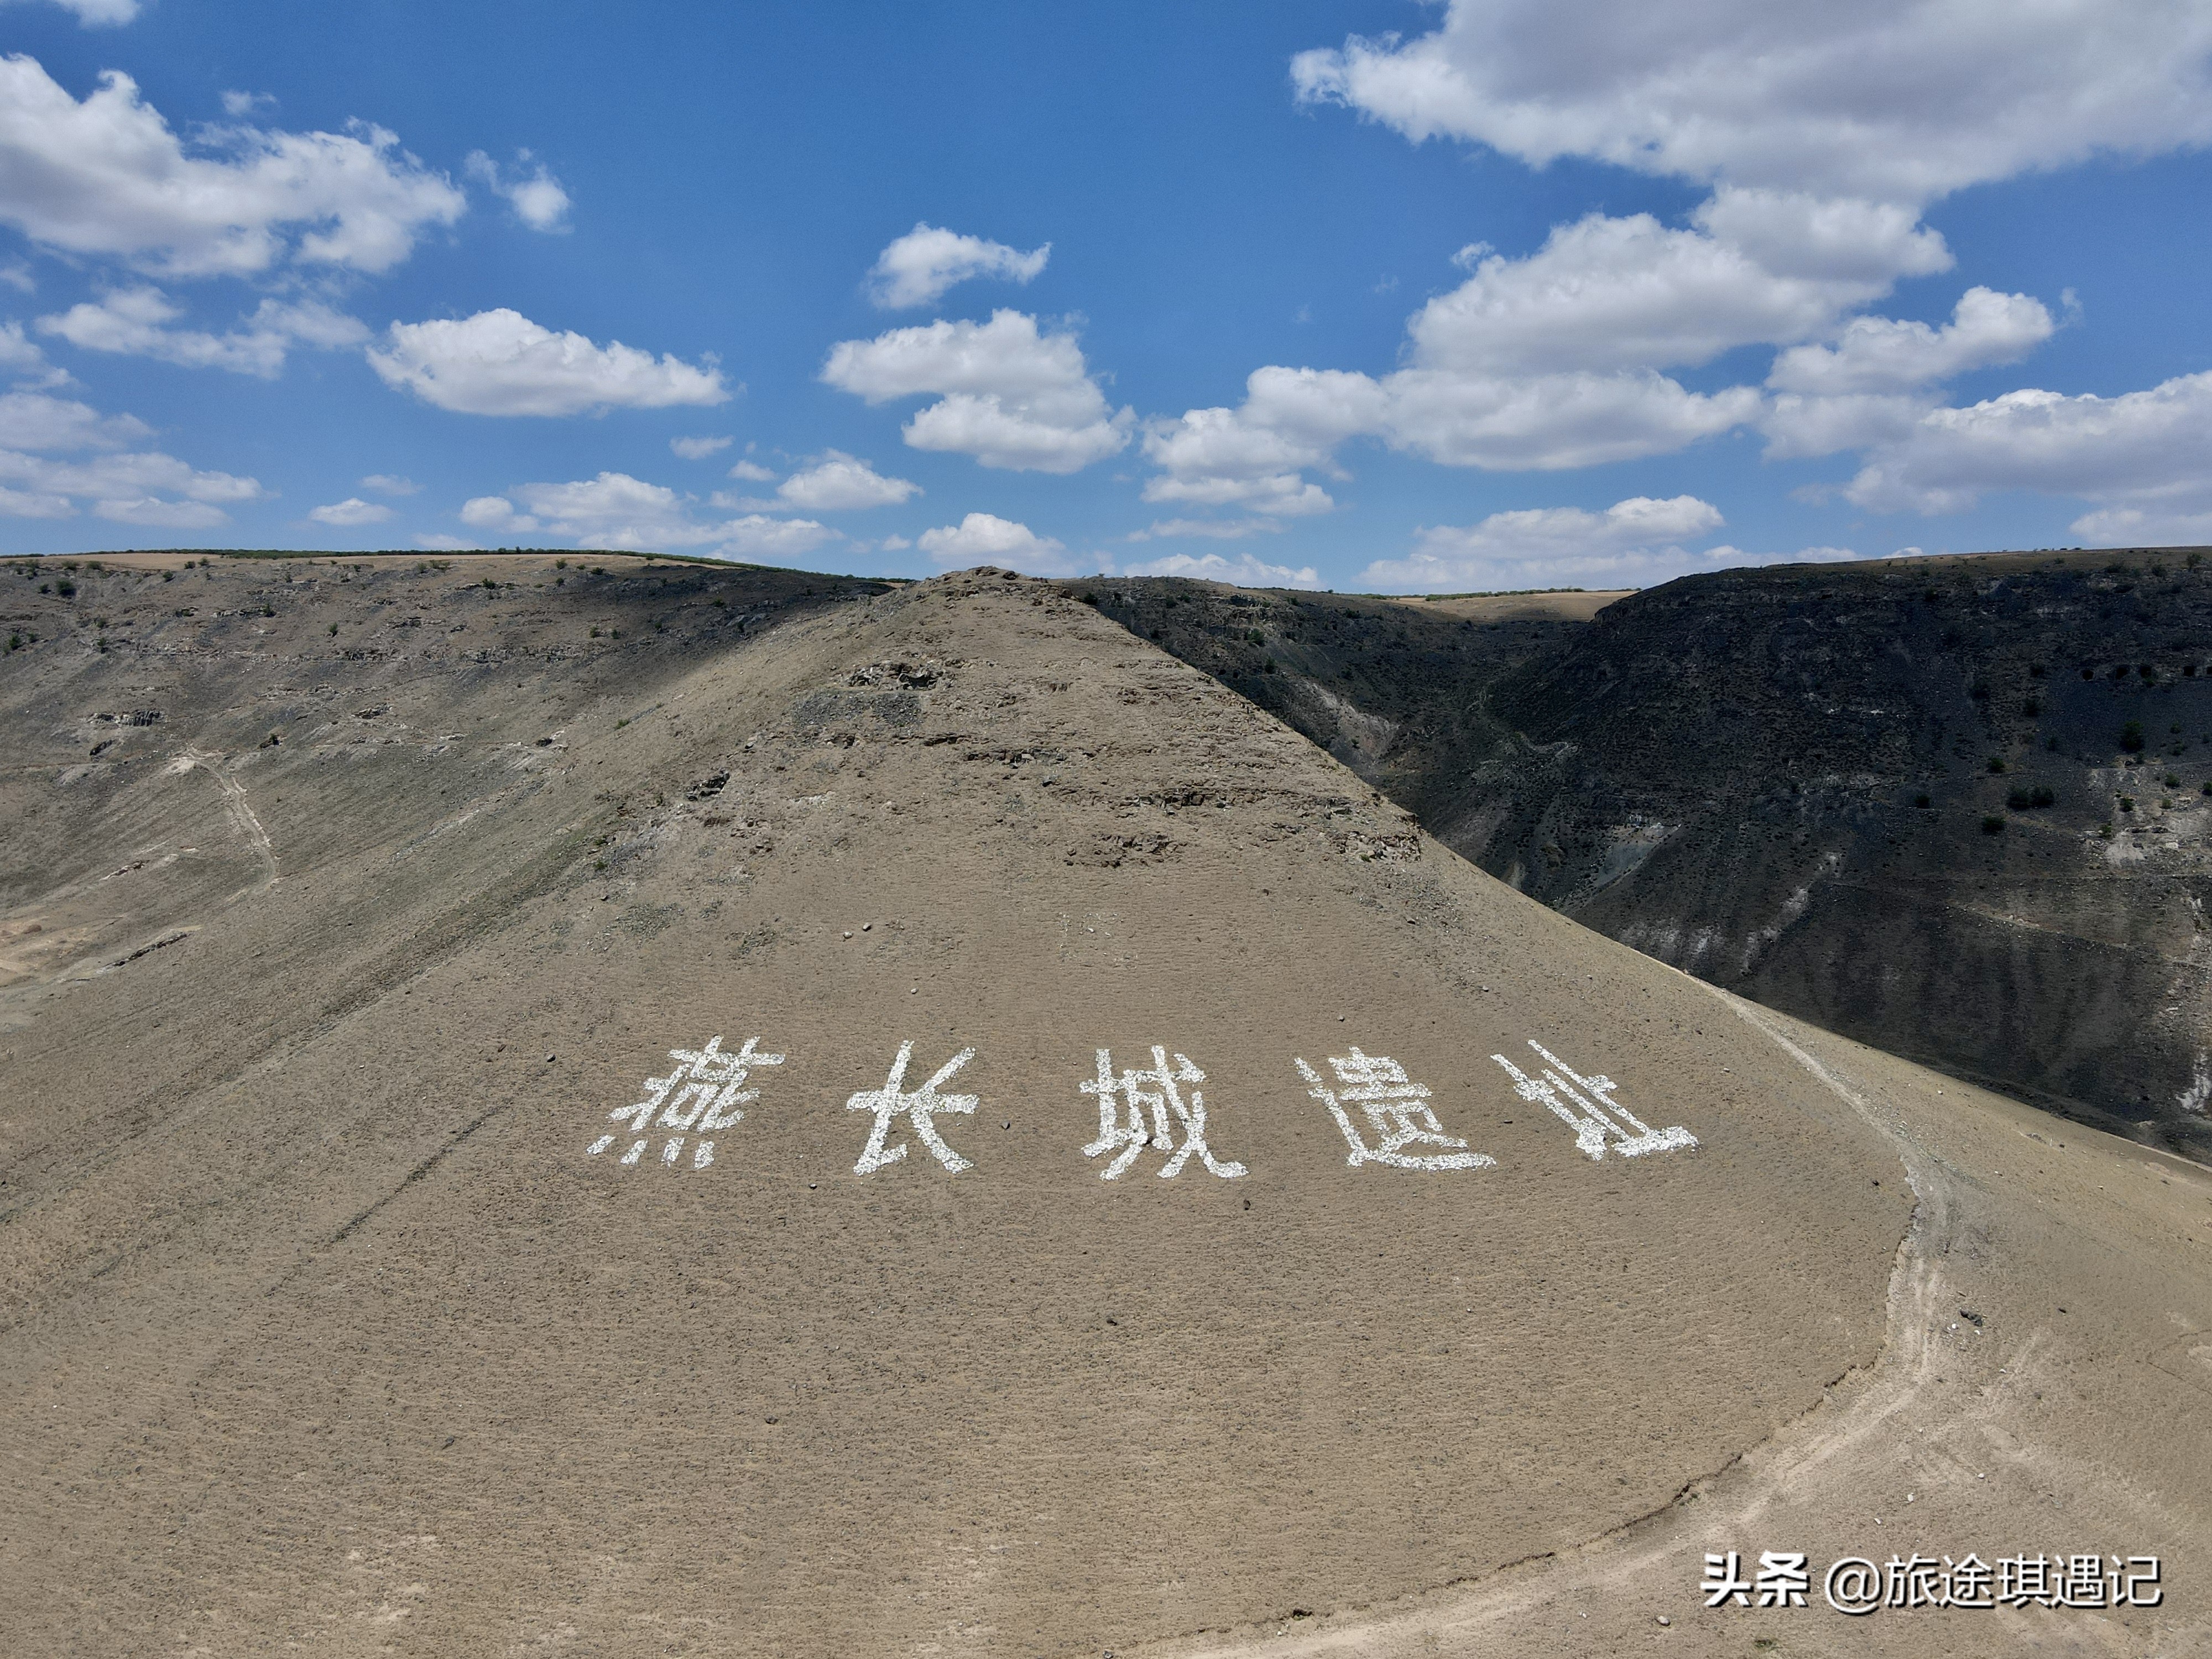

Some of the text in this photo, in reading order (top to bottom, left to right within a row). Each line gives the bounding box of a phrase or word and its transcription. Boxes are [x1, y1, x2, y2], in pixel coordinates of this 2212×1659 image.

[586, 1036, 1702, 1182] 燕长城遗址
